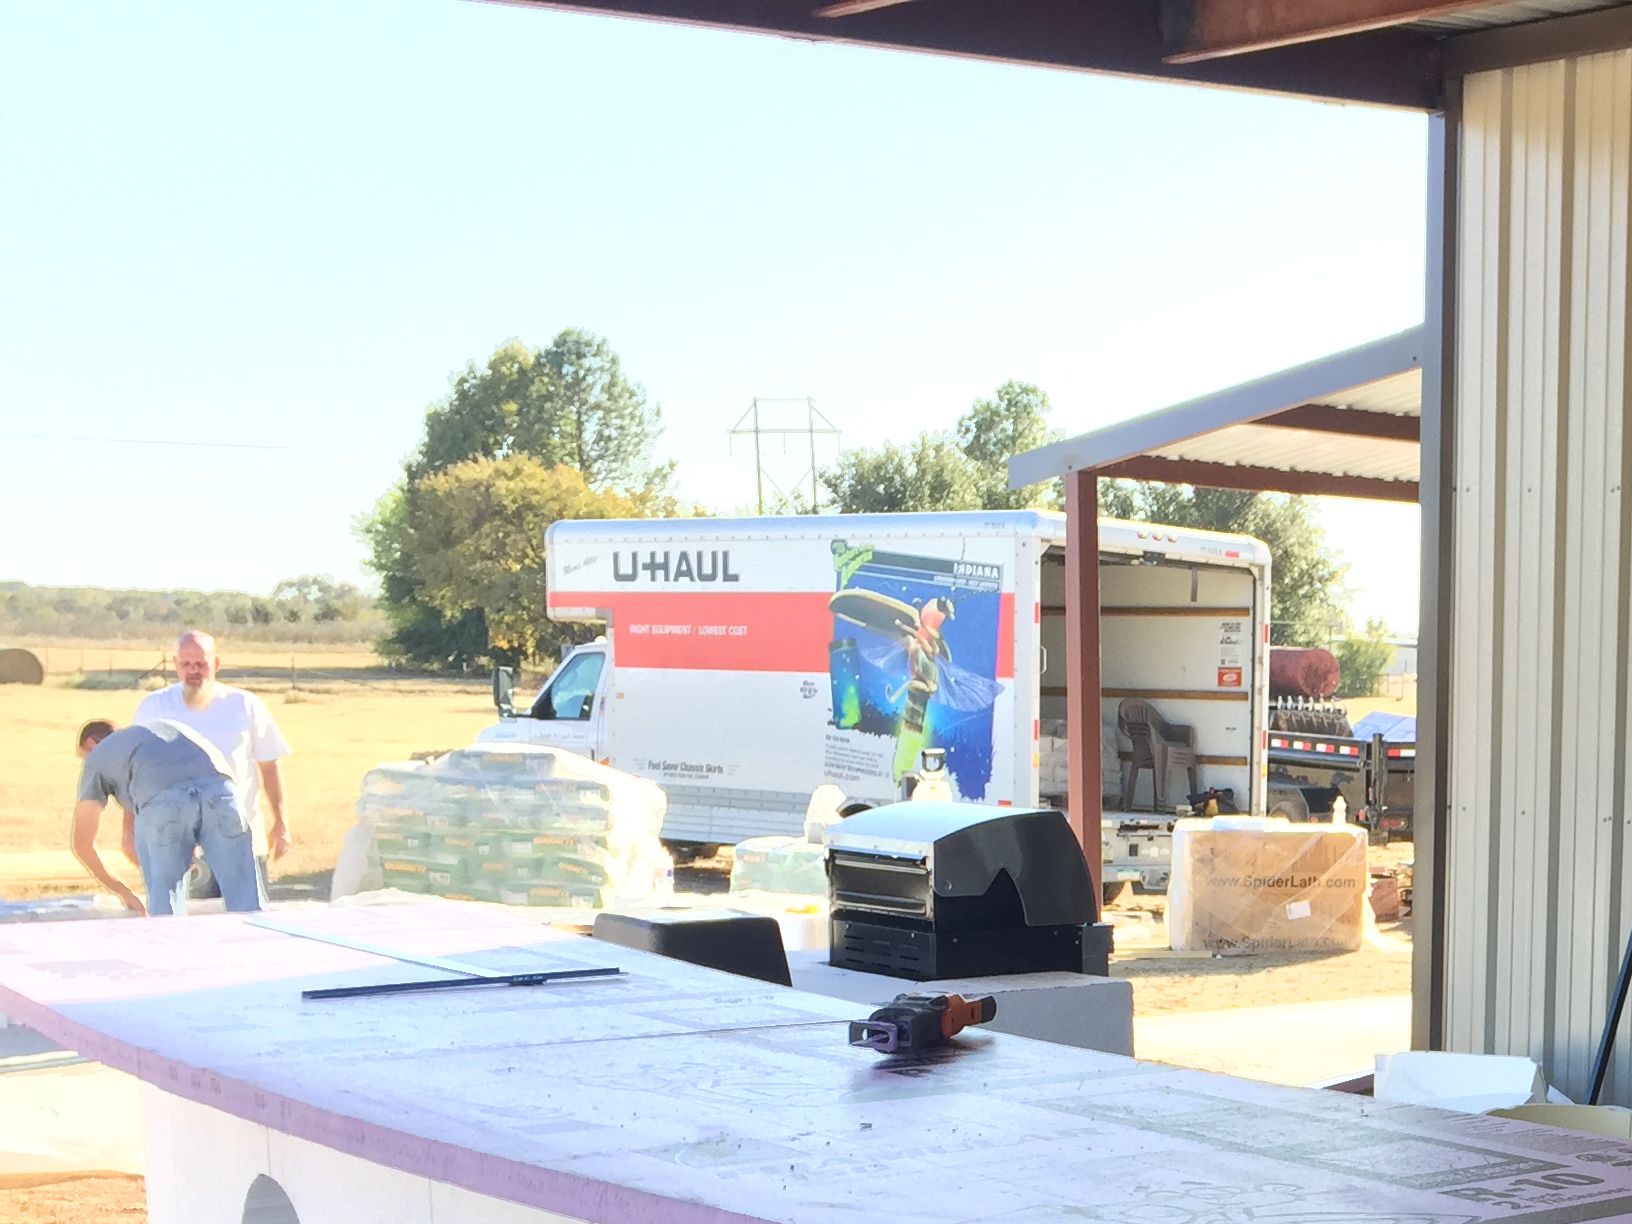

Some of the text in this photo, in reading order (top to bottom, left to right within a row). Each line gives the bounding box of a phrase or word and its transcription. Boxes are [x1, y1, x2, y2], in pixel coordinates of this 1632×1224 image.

[613, 550, 740, 582] U-HAUL
[953, 562, 999, 580] INDIANA
[698, 625, 727, 636] LOWEST
[728, 625, 748, 636] COST
[1437, 1173, 1605, 1203] R-10
